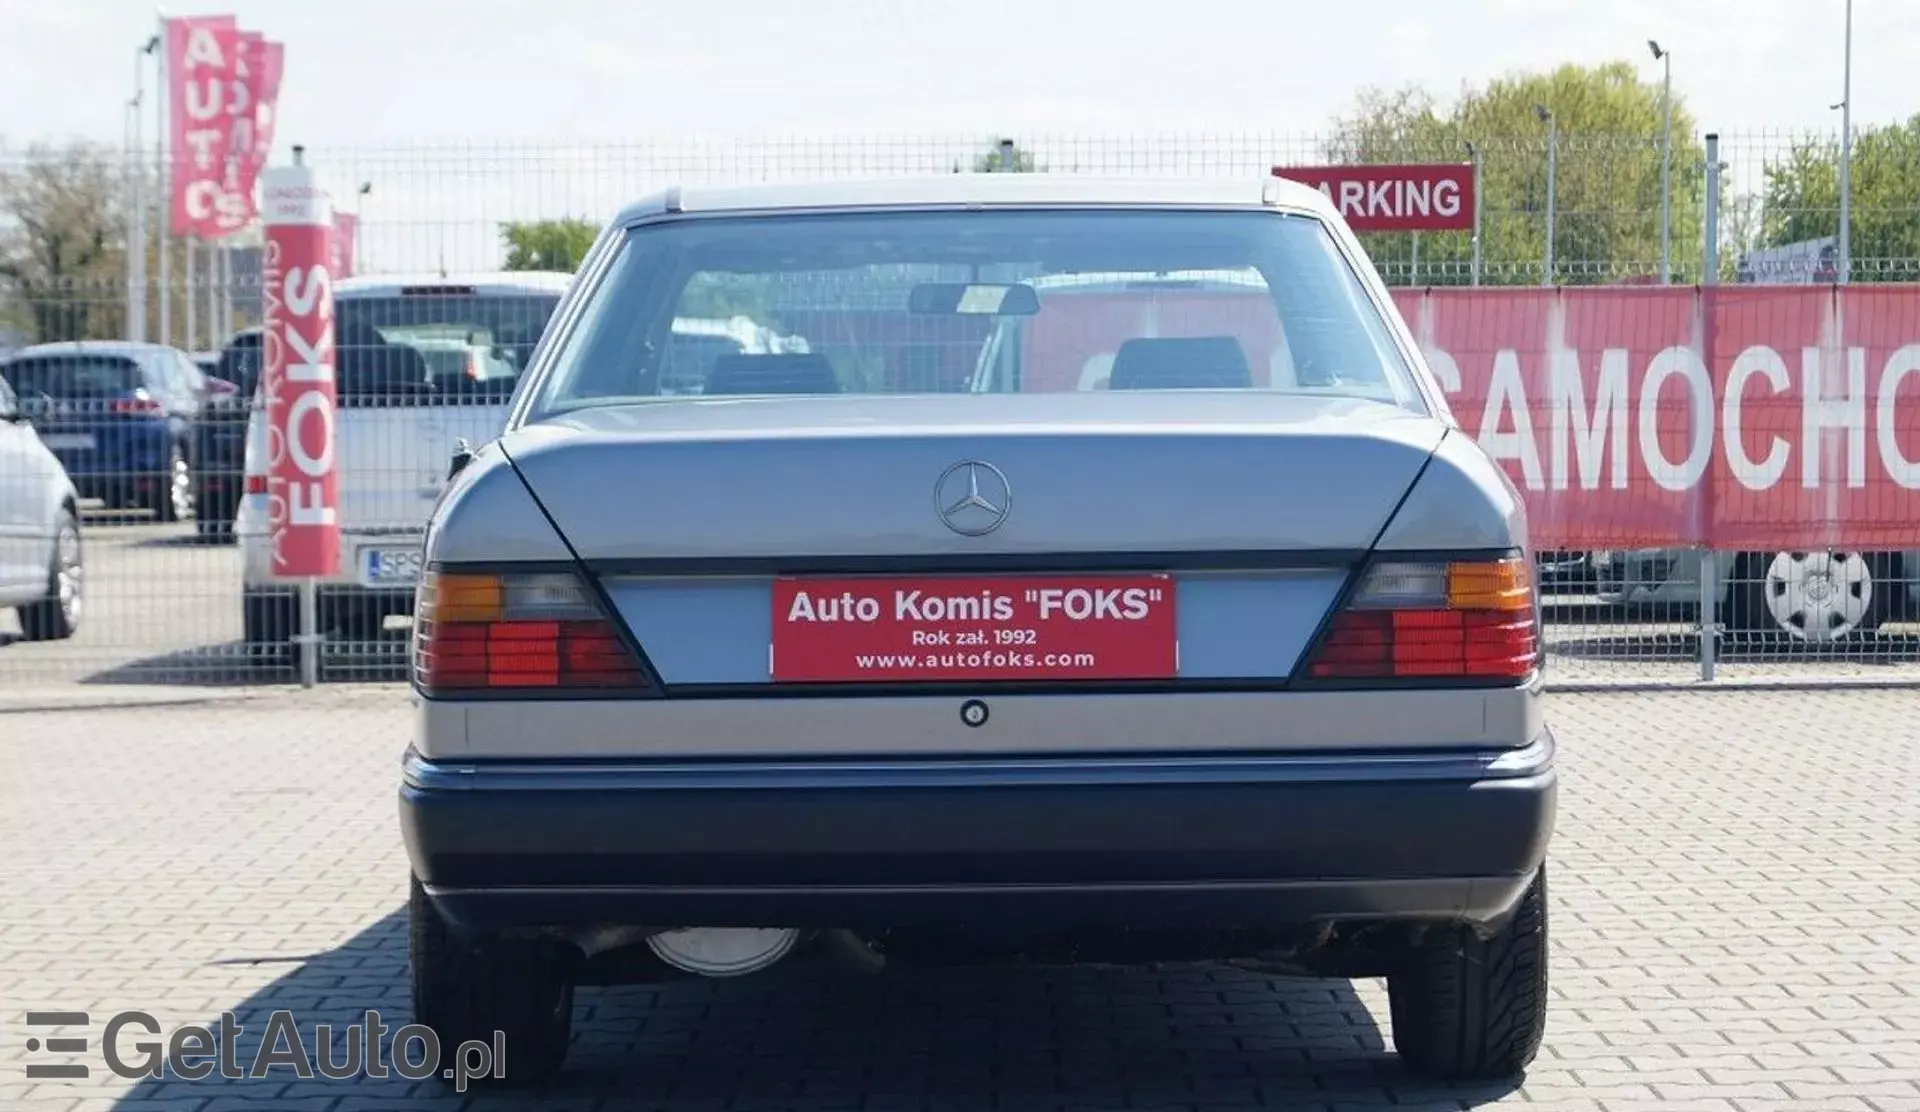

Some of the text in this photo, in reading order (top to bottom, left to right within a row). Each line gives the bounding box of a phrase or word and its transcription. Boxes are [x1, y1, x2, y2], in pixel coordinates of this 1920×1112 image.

[1315, 180, 1460, 218] RKING
[284, 263, 336, 526] FOKS
[1438, 344, 1920, 492] AMOCHO
[788, 588, 1162, 622] Auto Komis "FOKS"
[913, 629, 1037, 646] Rok zał. 1992
[855, 650, 1096, 670] www.autofoks.com
